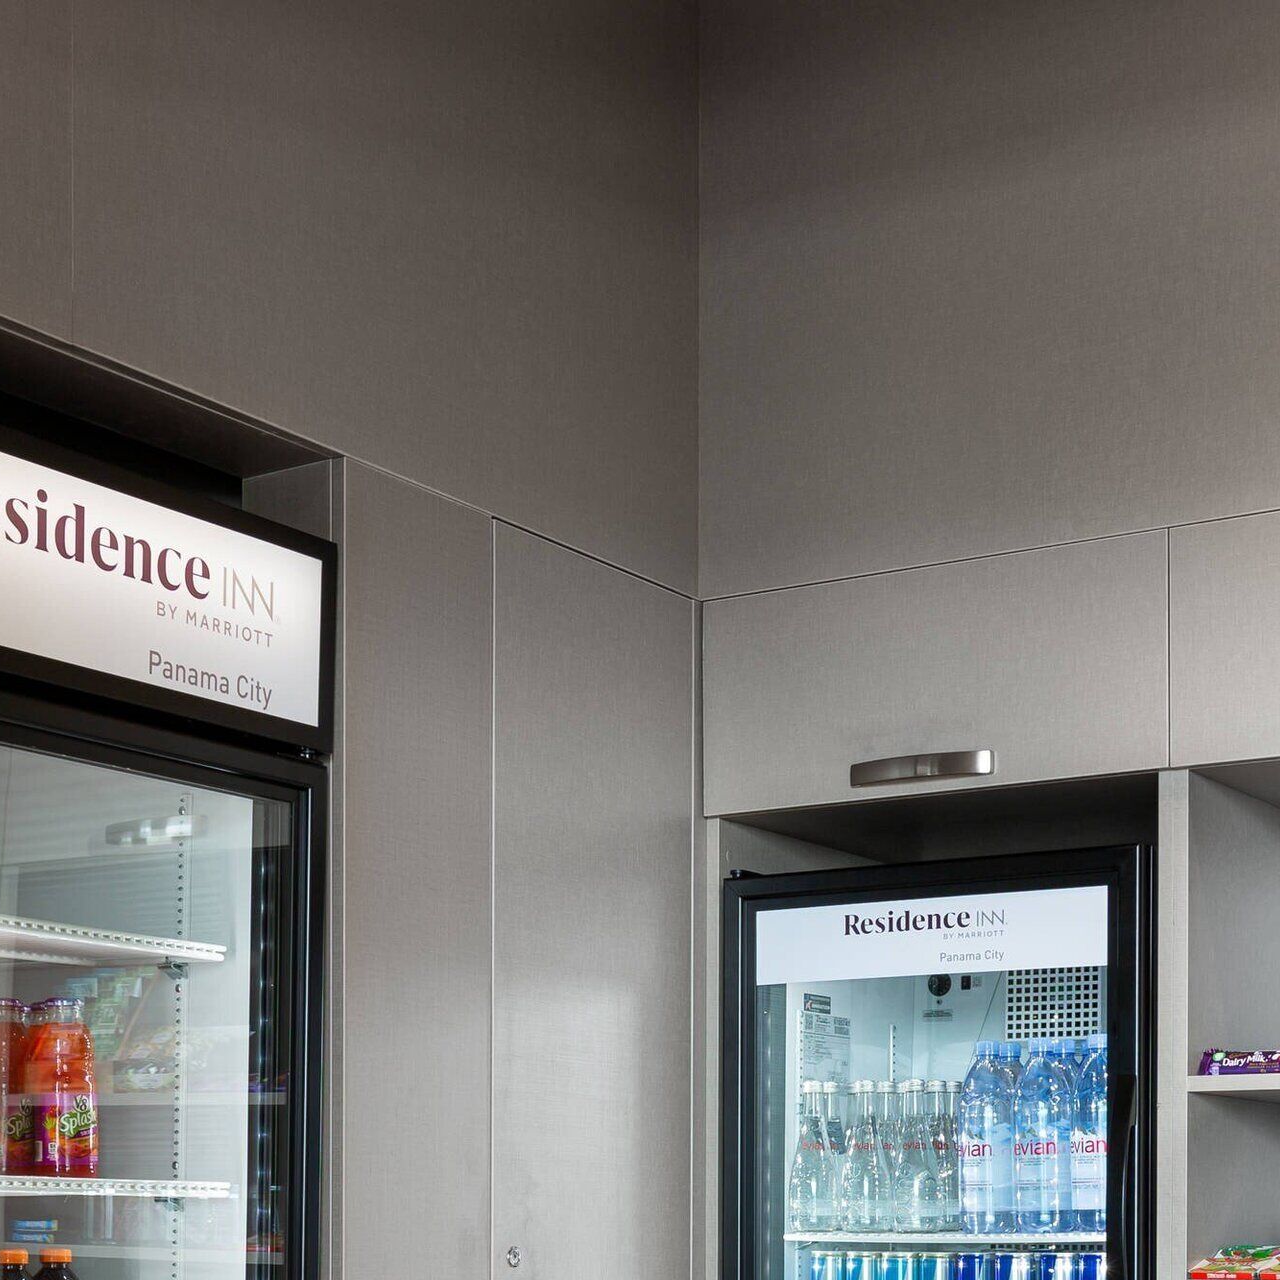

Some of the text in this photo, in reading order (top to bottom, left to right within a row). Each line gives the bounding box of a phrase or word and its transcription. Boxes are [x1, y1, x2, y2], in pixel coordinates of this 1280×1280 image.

[223, 566, 275, 622] INN
[156, 601, 274, 648] BY MARRIOTT
[148, 650, 273, 710] Panama City
[843, 909, 1006, 937] Residence INN
[958, 929, 1005, 940] MARRIOTT
[939, 949, 1005, 963] Panama City
[1222, 1055, 1247, 1067] Dairy
[1247, 1052, 1268, 1063] Milk
[1013, 1139, 1057, 1156] evian
[1070, 1137, 1108, 1155] evian
